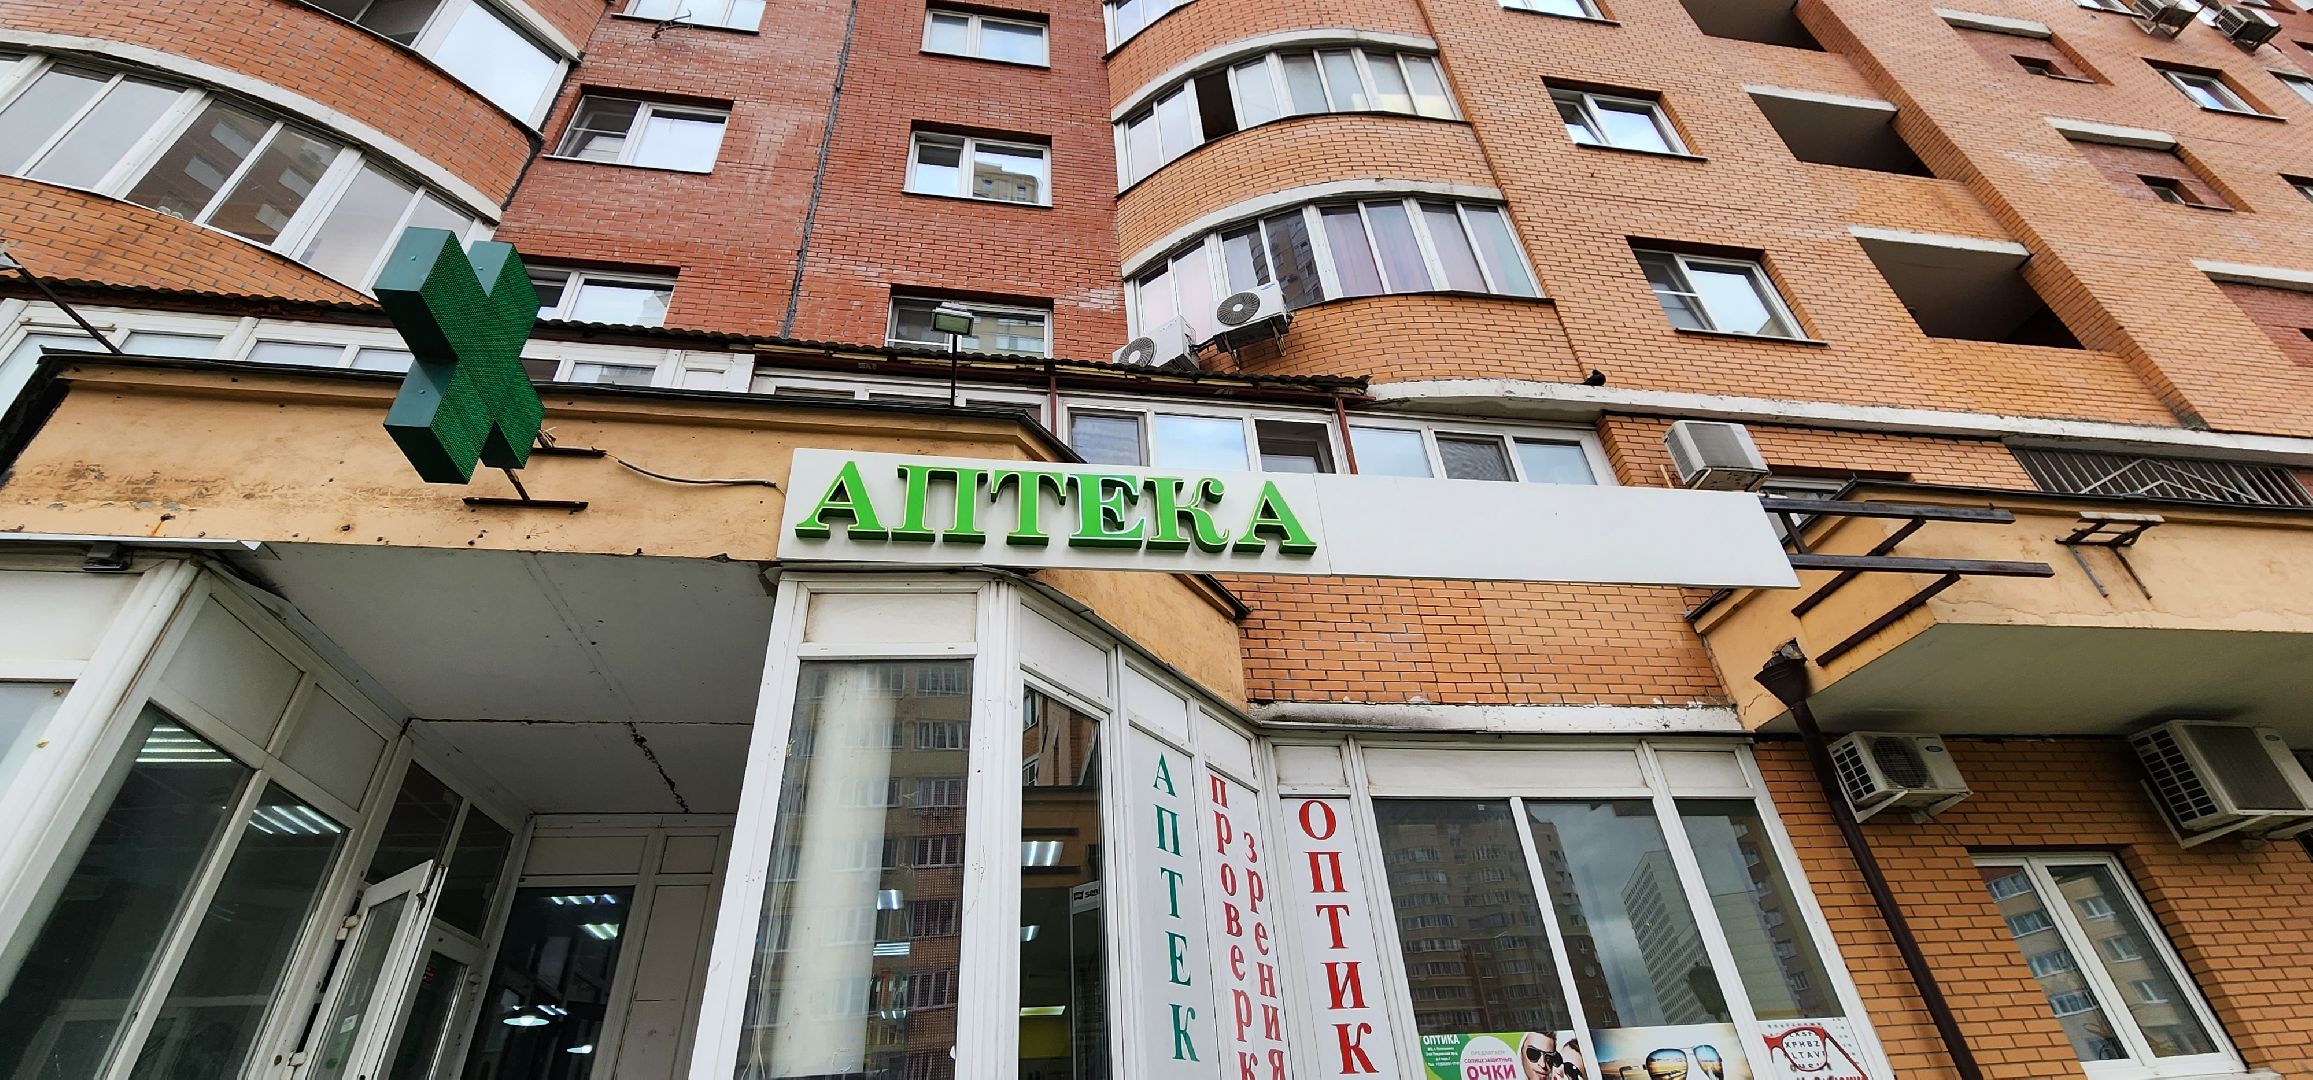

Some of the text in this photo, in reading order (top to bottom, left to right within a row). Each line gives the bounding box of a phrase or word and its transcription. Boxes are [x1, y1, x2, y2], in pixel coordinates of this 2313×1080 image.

[795, 460, 1317, 555] АПТЕКА
[1152, 751, 1200, 1062] АПТЕК
[1298, 799, 1380, 1075] ОПТИК
[1423, 1033, 1460, 1045] ОПТИКА
[1466, 1063, 1516, 1080] ОЧКИ
